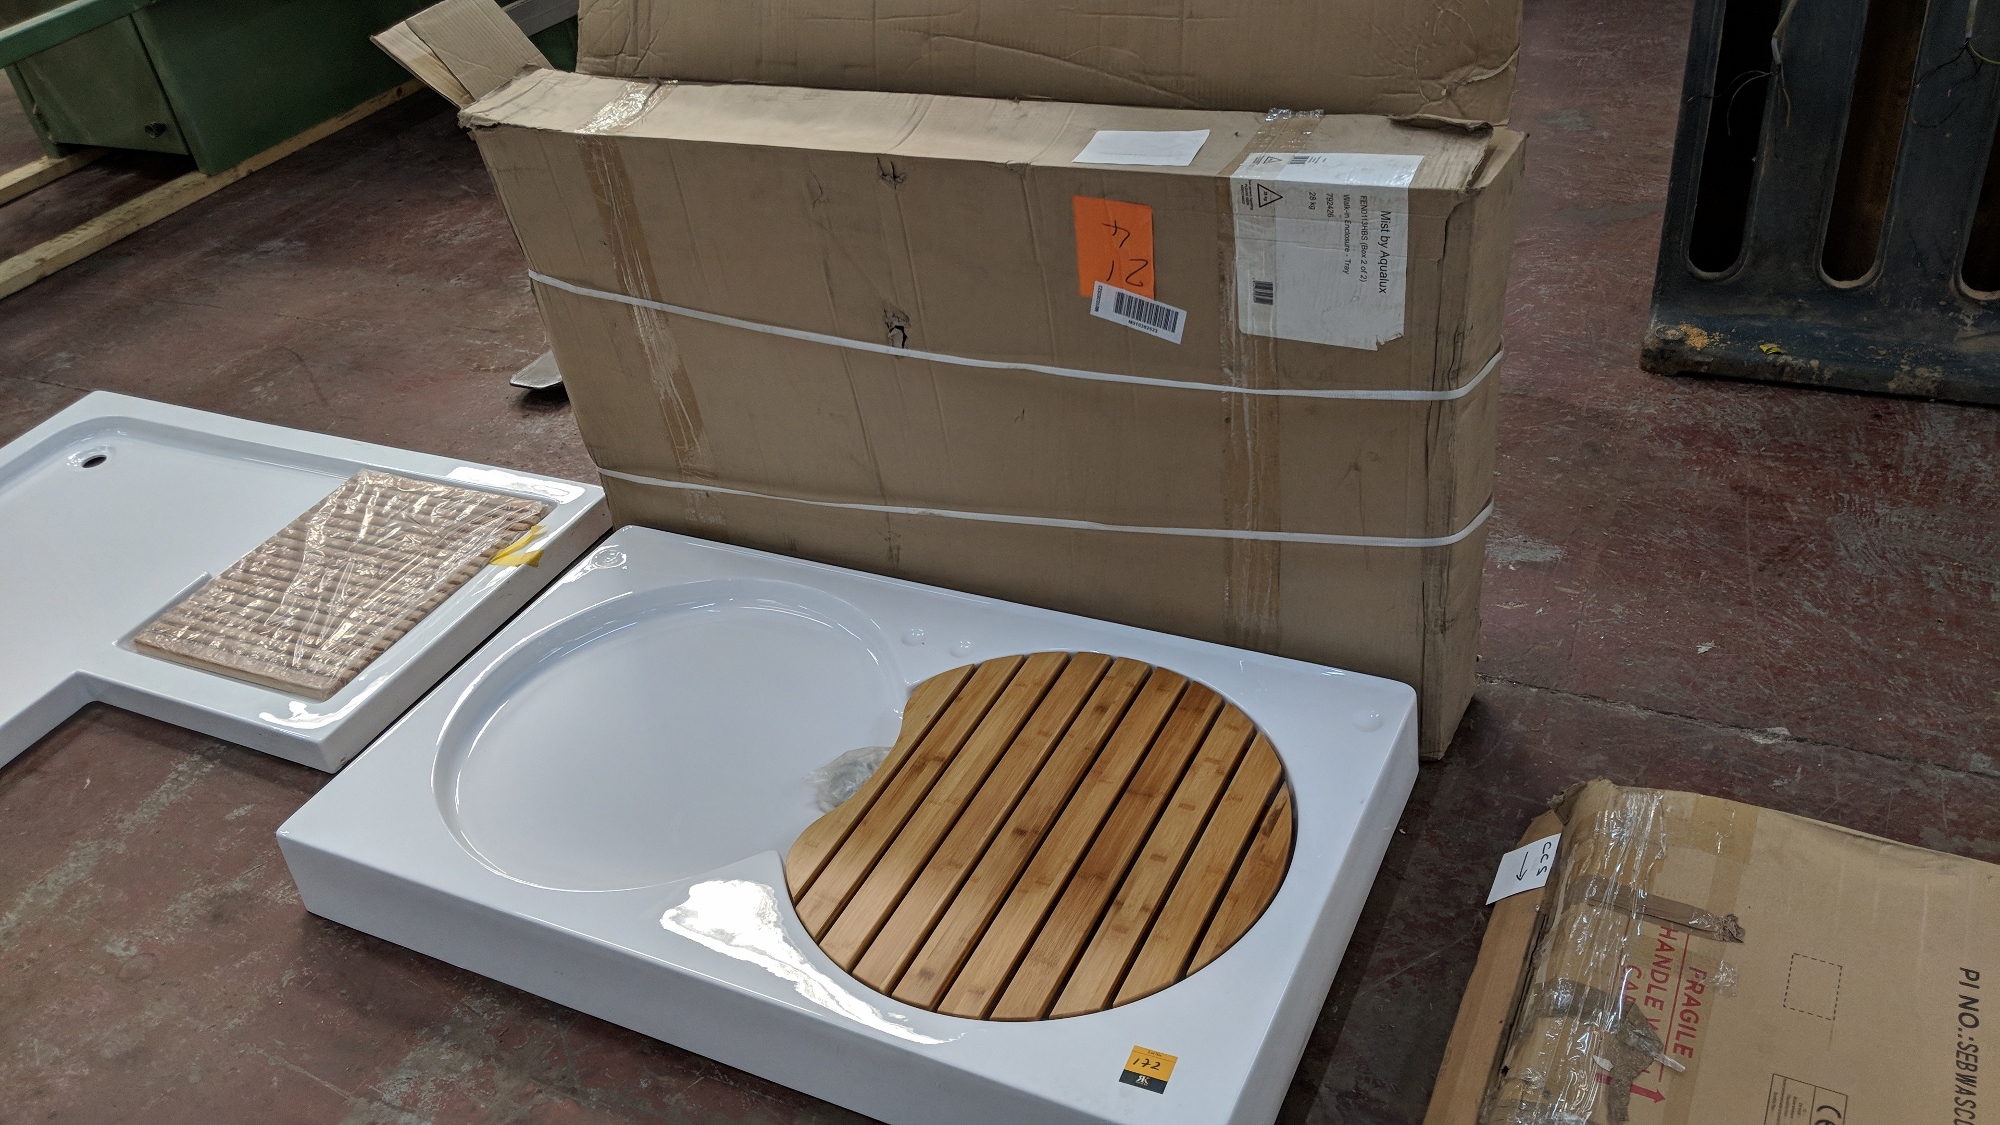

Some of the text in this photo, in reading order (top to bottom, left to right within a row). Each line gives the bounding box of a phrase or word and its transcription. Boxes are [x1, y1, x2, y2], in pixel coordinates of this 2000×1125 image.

[1308, 191, 1317, 210] 28 kg
[1326, 193, 1335, 218] 792426
[1343, 194, 1351, 219] Walk-in
[1360, 195, 1369, 241] FEN0113HBS
[1344, 220, 1352, 252] Enclosure
[1359, 242, 1369, 258] (Box
[1378, 210, 1392, 294] Mist by Aqualux
[1342, 258, 1352, 275] Tray
[1359, 274, 1368, 283] 2)
[1360, 266, 1368, 274] of
[1644, 925, 1679, 1012] HANDLE
[1959, 967, 1980, 990] PI
[1672, 966, 1708, 1059] FRAGILE
[1132, 1057, 1161, 1071] 172
